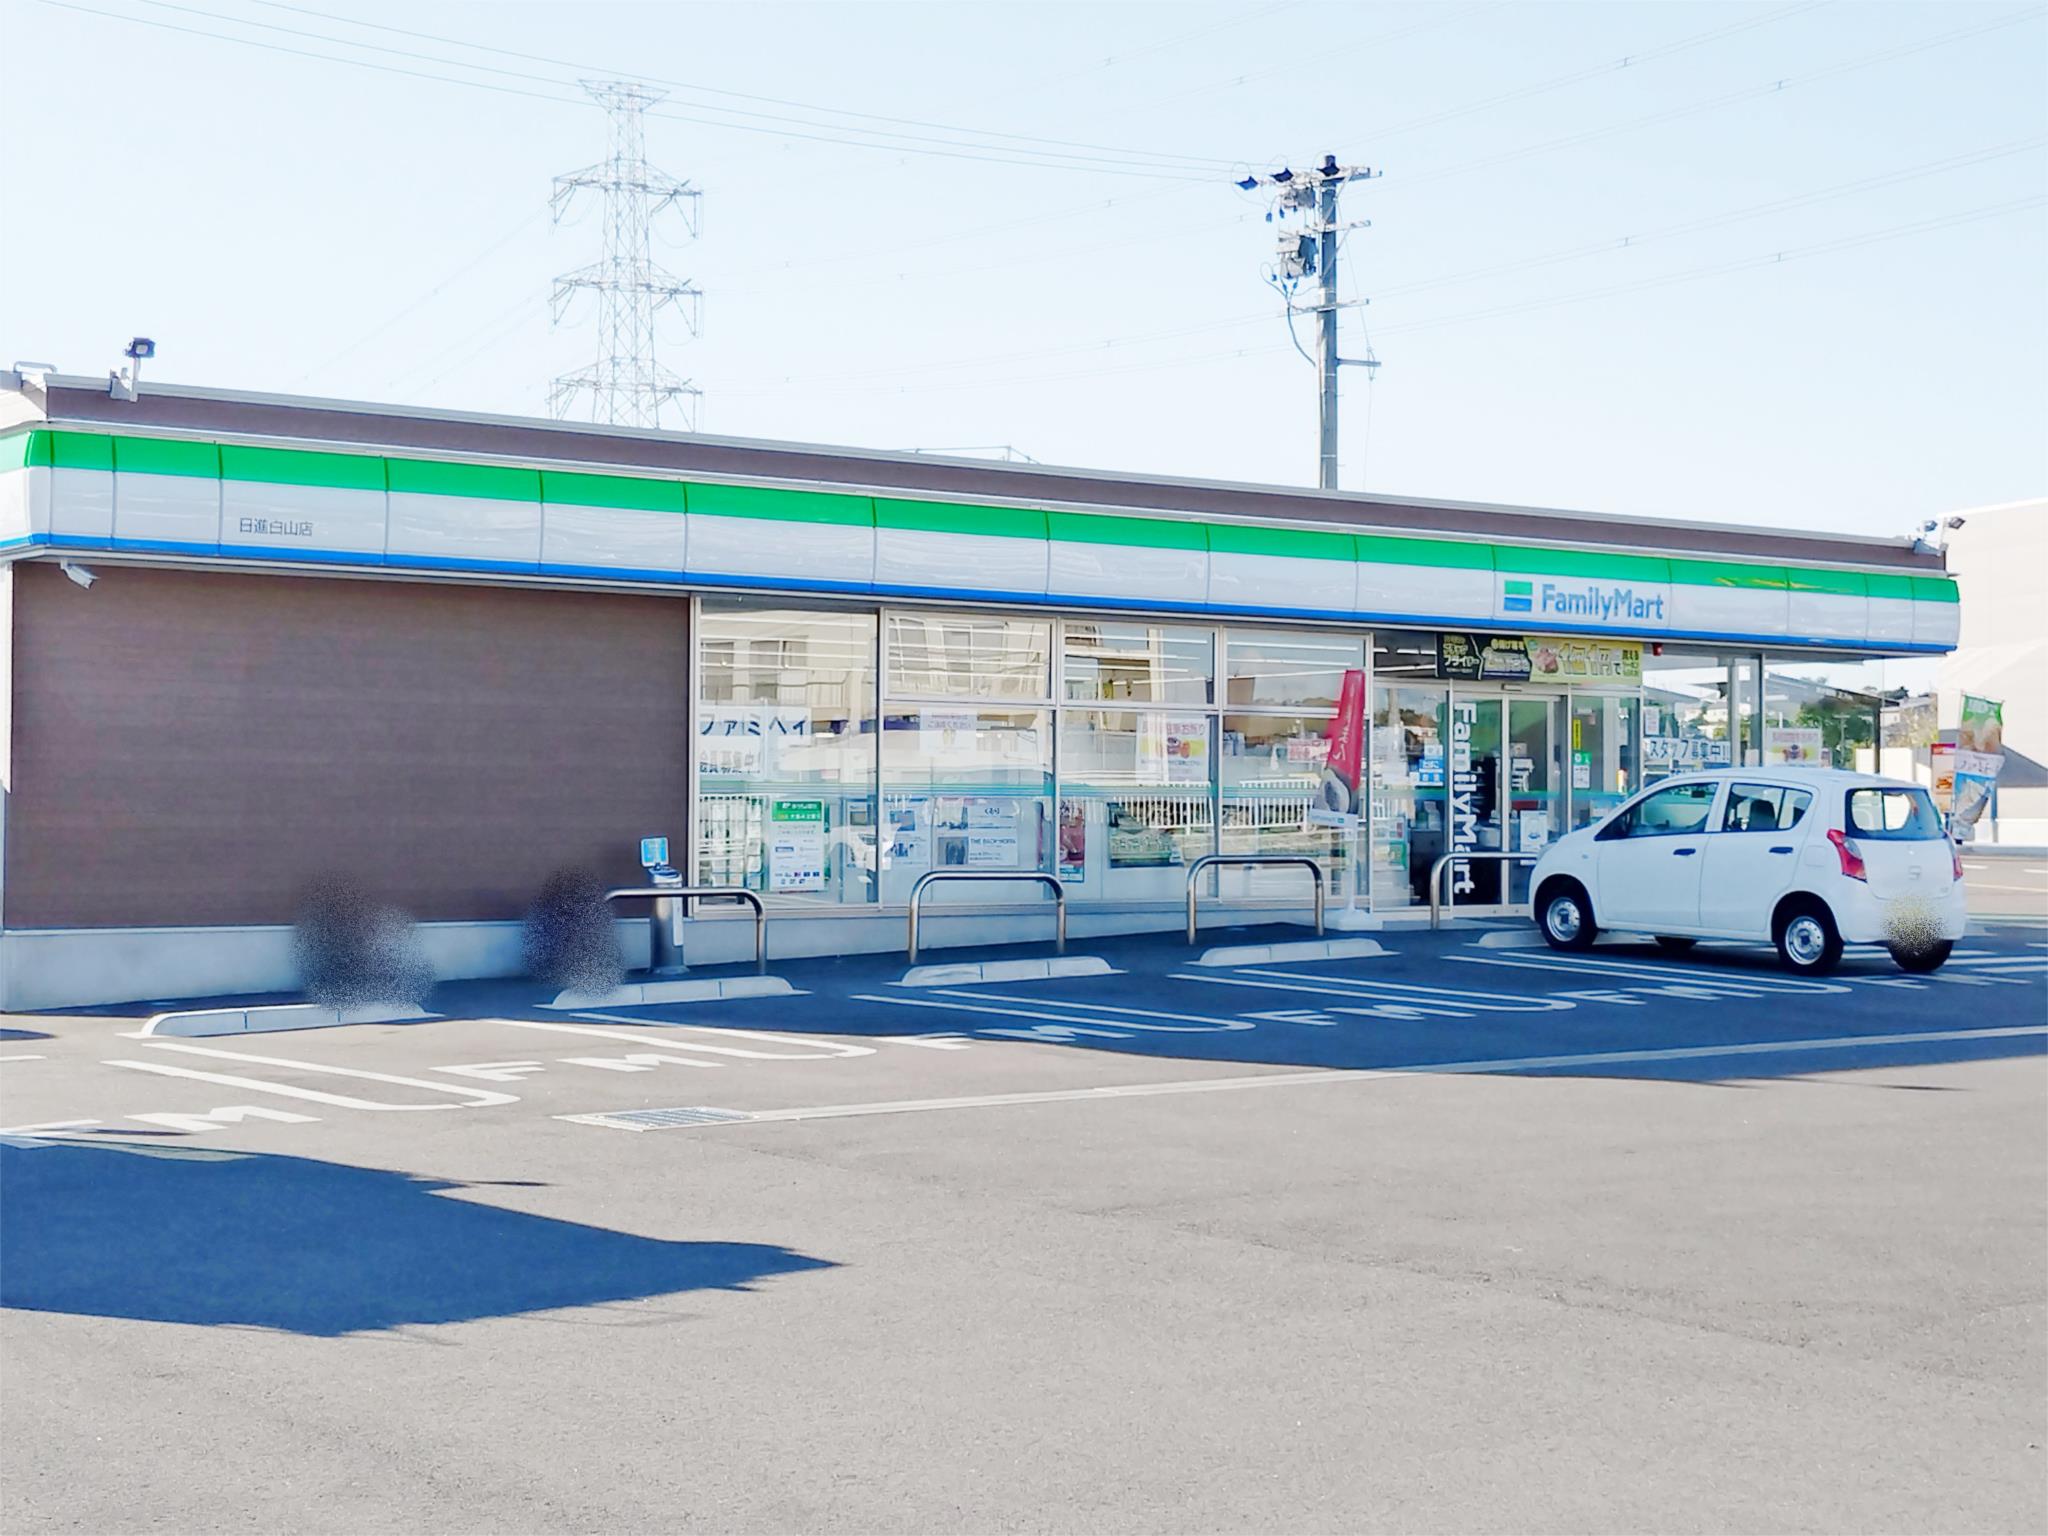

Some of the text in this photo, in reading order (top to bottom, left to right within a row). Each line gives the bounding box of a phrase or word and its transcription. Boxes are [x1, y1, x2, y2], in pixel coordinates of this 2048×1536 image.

[239, 517, 313, 536] 日進白山店
[1541, 583, 1664, 620] FamilyMart
